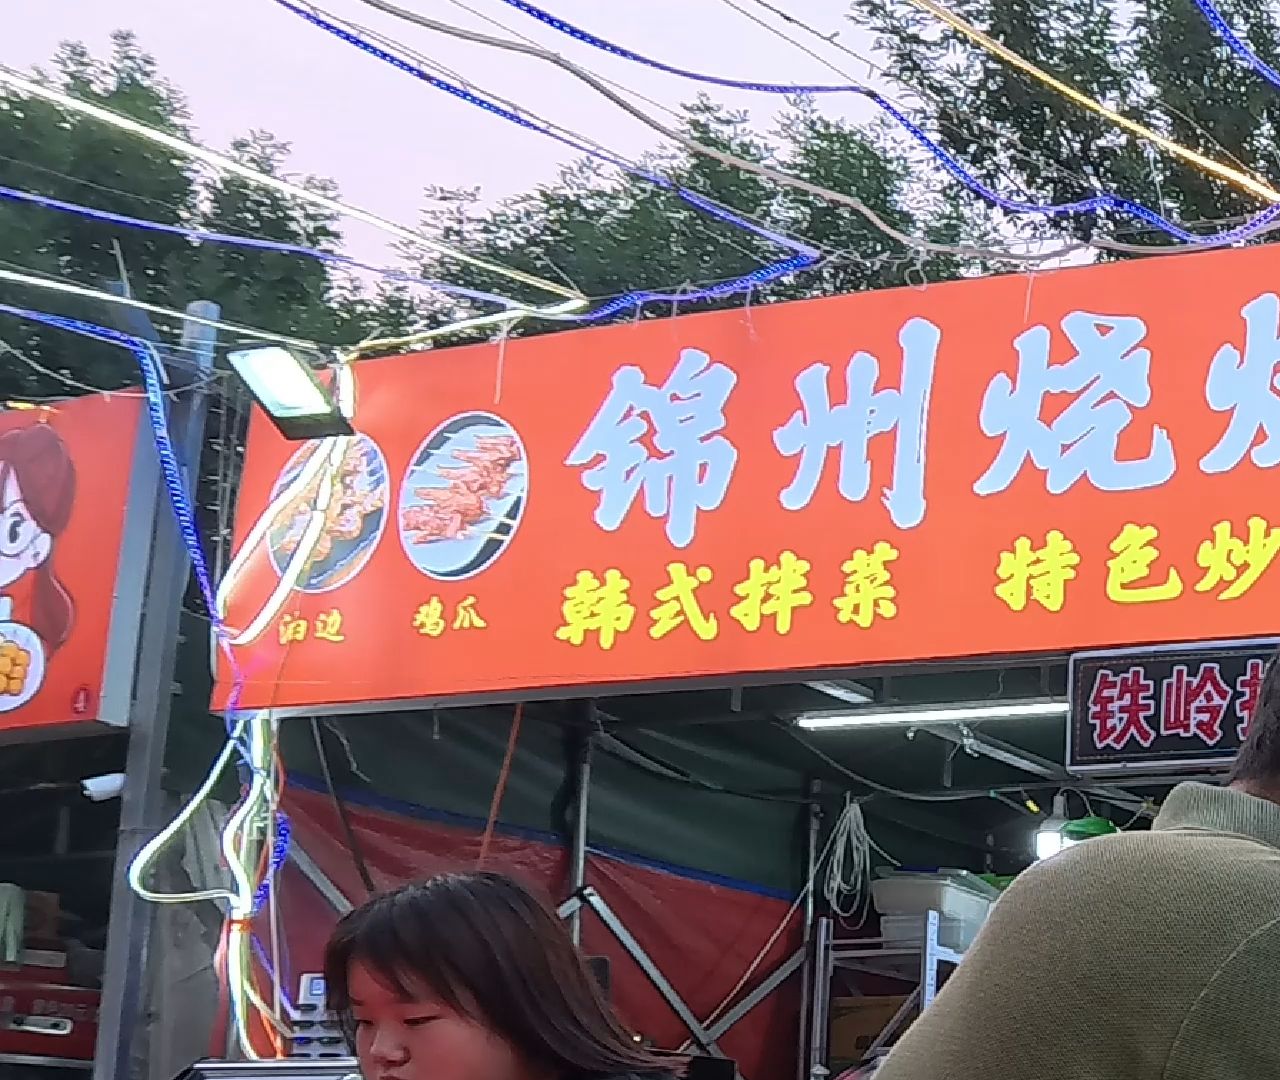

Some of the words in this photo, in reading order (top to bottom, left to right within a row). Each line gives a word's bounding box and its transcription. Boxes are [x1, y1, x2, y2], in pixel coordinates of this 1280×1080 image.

[411, 595, 487, 638] 鸡爪
[555, 541, 900, 650] 韩式拌菜
